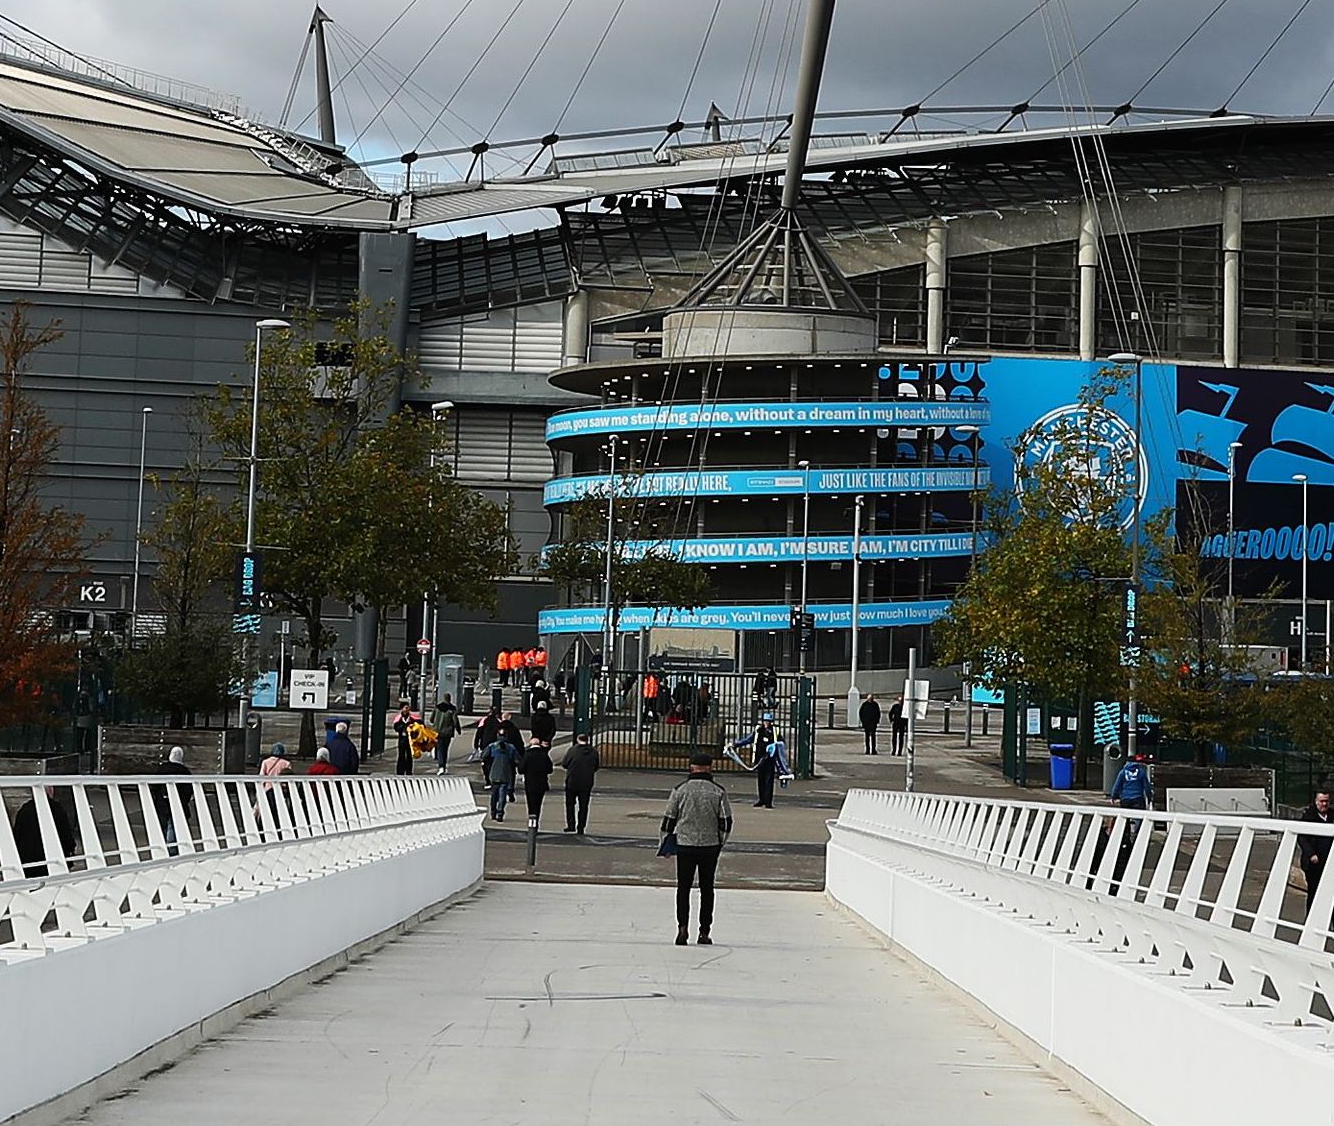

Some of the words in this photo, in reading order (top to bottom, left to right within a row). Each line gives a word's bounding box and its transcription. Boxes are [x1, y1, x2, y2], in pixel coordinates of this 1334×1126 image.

[573, 419, 588, 432] you
[589, 417, 609, 428] saw
[611, 415, 627, 426] me
[631, 411, 688, 425] standing
[690, 408, 733, 423] alone,
[735, 407, 794, 422] without
[797, 411, 806, 421] a
[809, 407, 856, 421] dream
[858, 407, 870, 420] in
[873, 409, 894, 423] my
[895, 407, 928, 421] heart,
[929, 406, 964, 420] without
[702, 474, 732, 492] HERE,
[819, 472, 844, 489] JUST
[846, 472, 866, 488] LIKE
[868, 472, 886, 488] THE
[888, 472, 909, 487] FANS
[911, 471, 921, 487] OF
[922, 471, 935, 487] THE
[686, 543, 736, 557] KNOW
[738, 544, 744, 556] I
[745, 543, 778, 557] AM,
[780, 542, 804, 555] I'M
[807, 541, 849, 555] SURE
[859, 541, 886, 555] AM,
[888, 540, 909, 553] I'M
[911, 539, 937, 552] CITY
[938, 539, 957, 551] TILL
[80, 586, 106, 602] K2
[622, 614, 650, 624] when
[681, 614, 698, 624] are
[731, 611, 762, 623] You'll
[764, 613, 790, 623] neve
[830, 610, 851, 623] just
[877, 608, 904, 620] much
[910, 607, 927, 619] love
[294, 680, 325, 688] CHECK-IN
